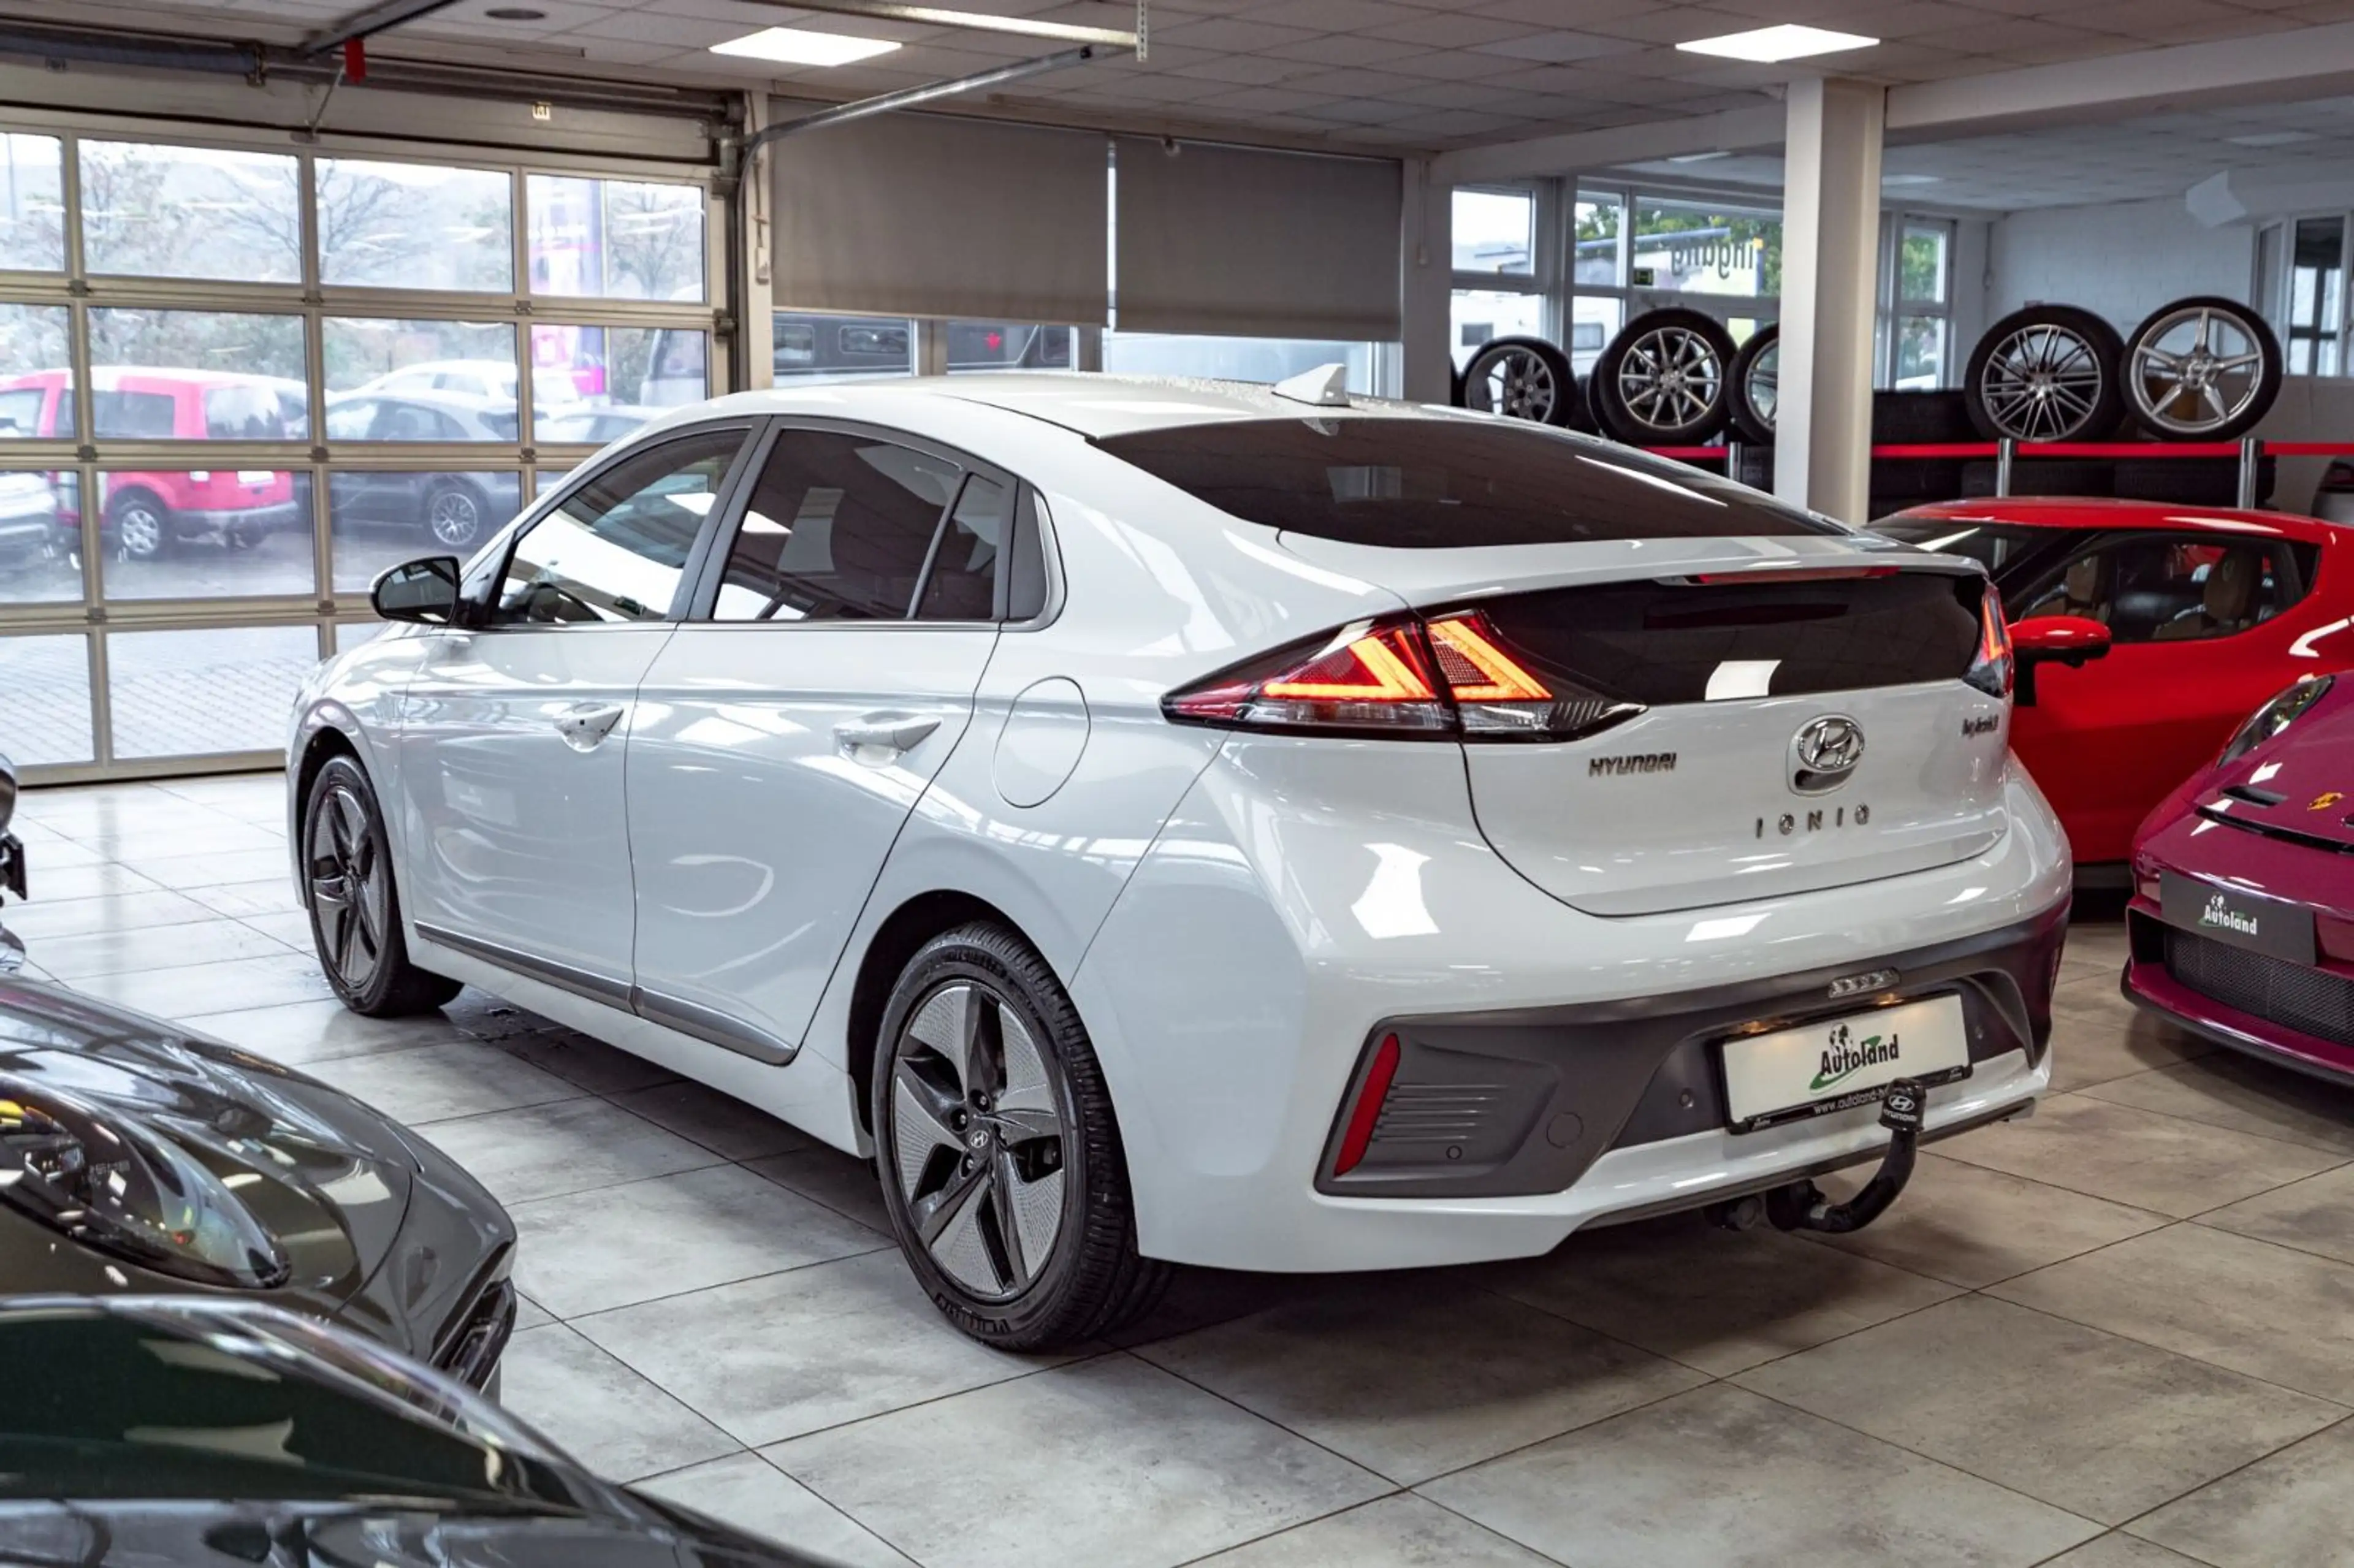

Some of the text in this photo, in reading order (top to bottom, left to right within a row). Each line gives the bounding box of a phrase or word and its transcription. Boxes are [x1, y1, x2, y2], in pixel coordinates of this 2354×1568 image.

[1588, 752, 1677, 777] HYUNDAI
[2203, 904, 2257, 935] Autoland
[1820, 1033, 1899, 1075] Autoland
